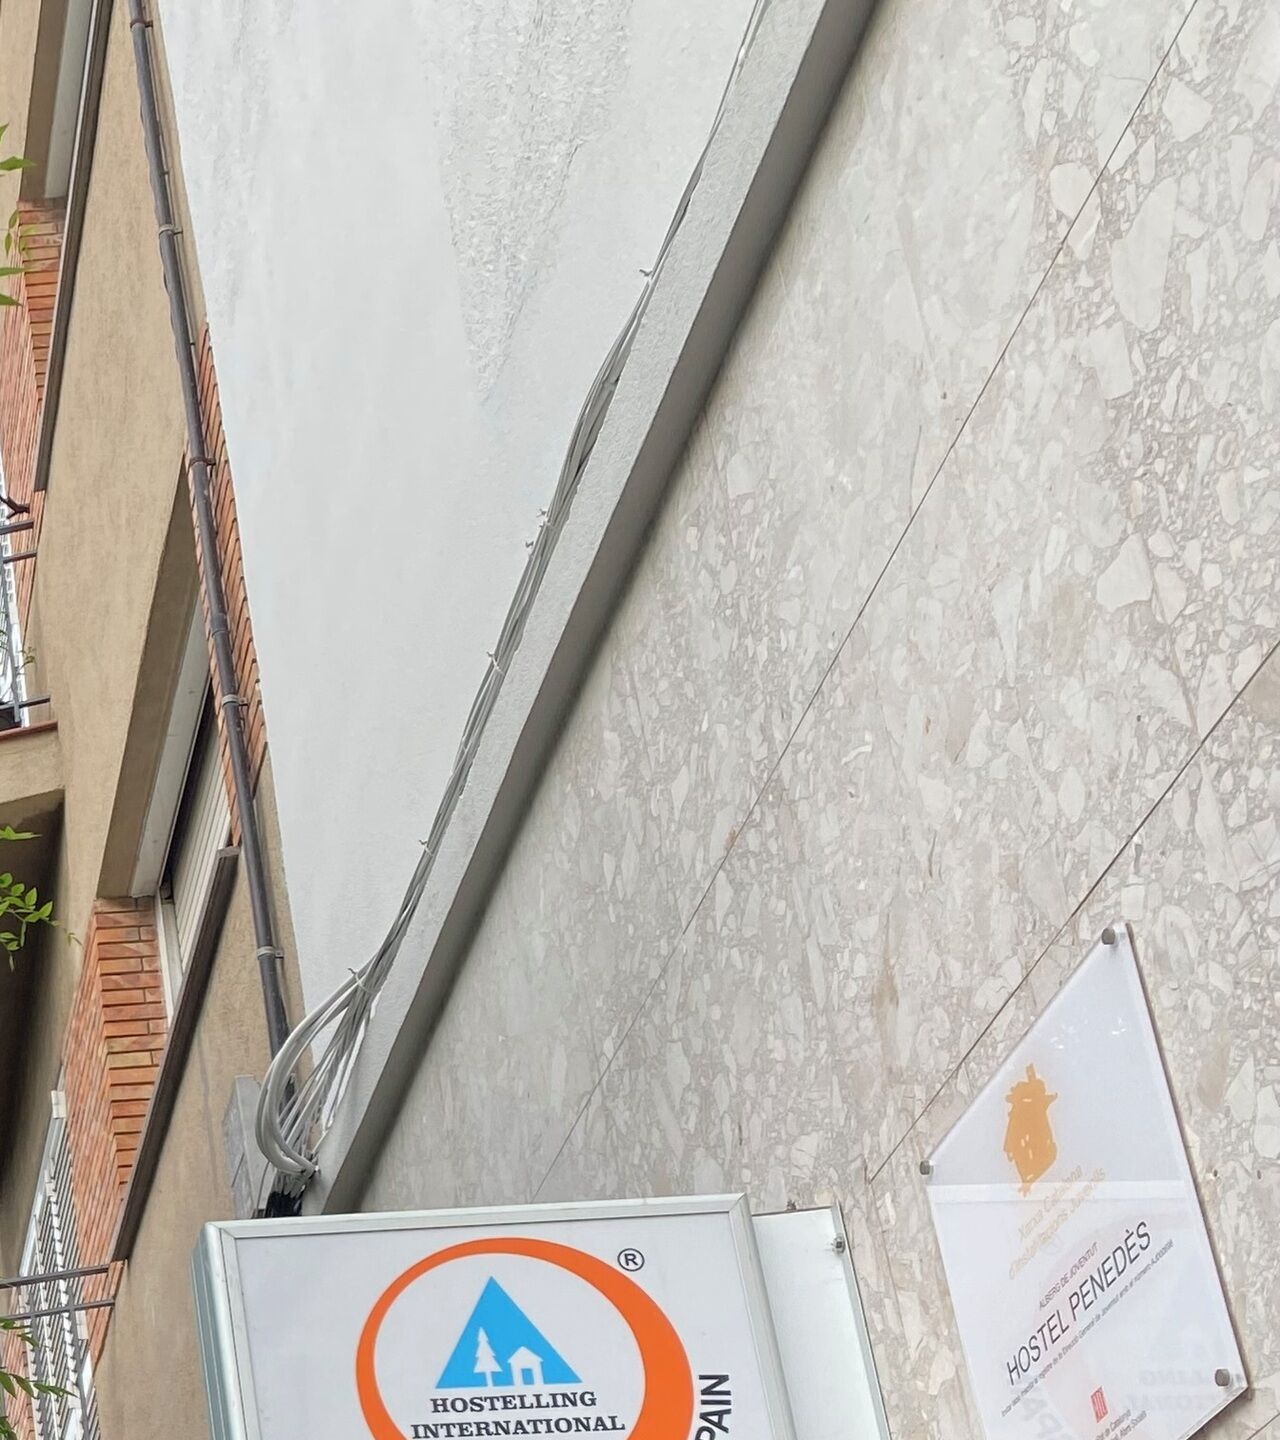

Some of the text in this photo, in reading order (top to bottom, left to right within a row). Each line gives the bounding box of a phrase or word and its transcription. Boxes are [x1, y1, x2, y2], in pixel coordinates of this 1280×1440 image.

[1006, 1309, 1070, 1386] HOSTEL
[1069, 1221, 1151, 1322] PENEDÈS
[429, 1391, 597, 1414] HOSTELLING
[410, 1415, 626, 1440] INTERNATIONAL
